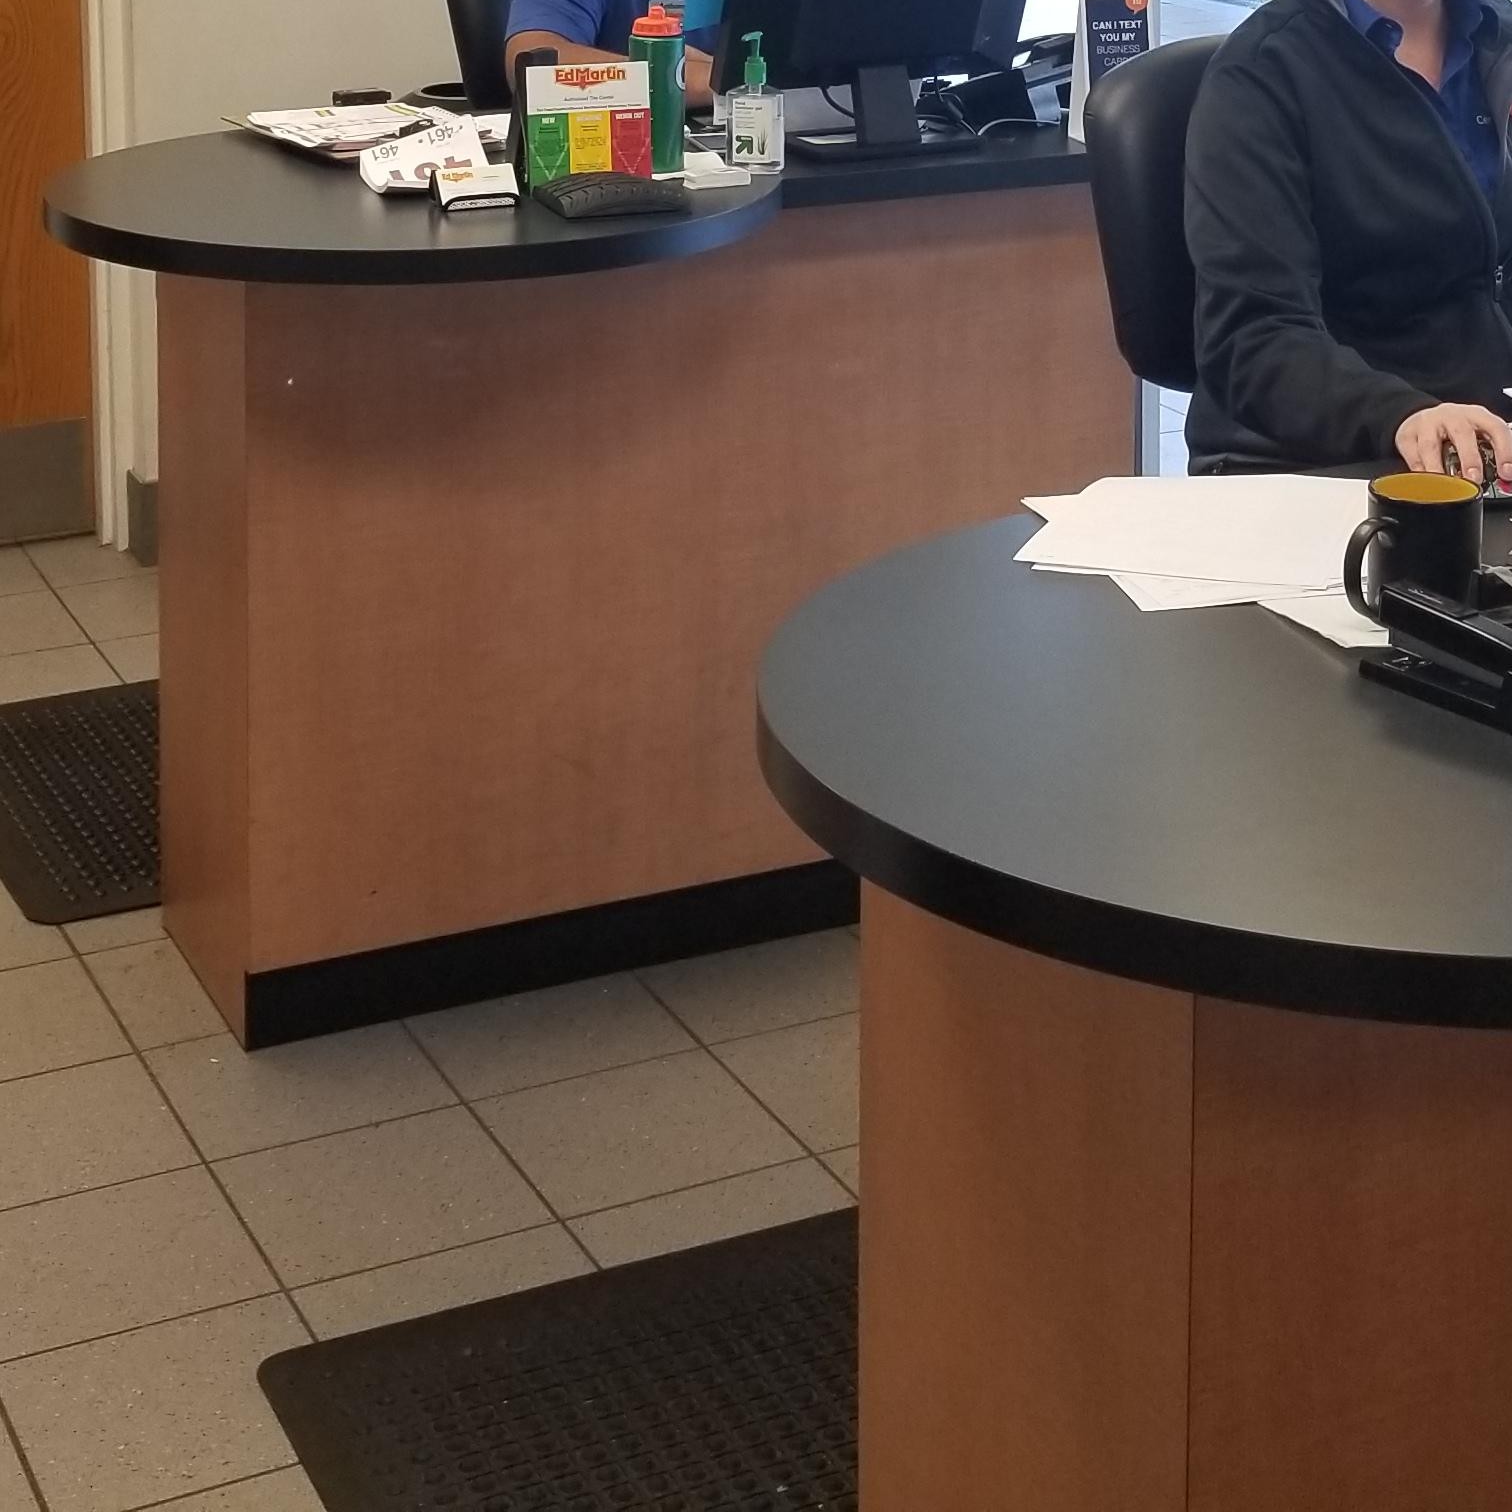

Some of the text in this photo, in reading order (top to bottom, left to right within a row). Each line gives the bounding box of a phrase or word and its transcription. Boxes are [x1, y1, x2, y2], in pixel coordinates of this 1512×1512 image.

[1092, 21, 1112, 30] CAN
[1119, 20, 1143, 29] TEXT
[1100, 33, 1136, 42] YOU MY
[1096, 44, 1140, 55] BUSINESS
[427, 125, 454, 145] 461
[371, 144, 399, 161] 461
